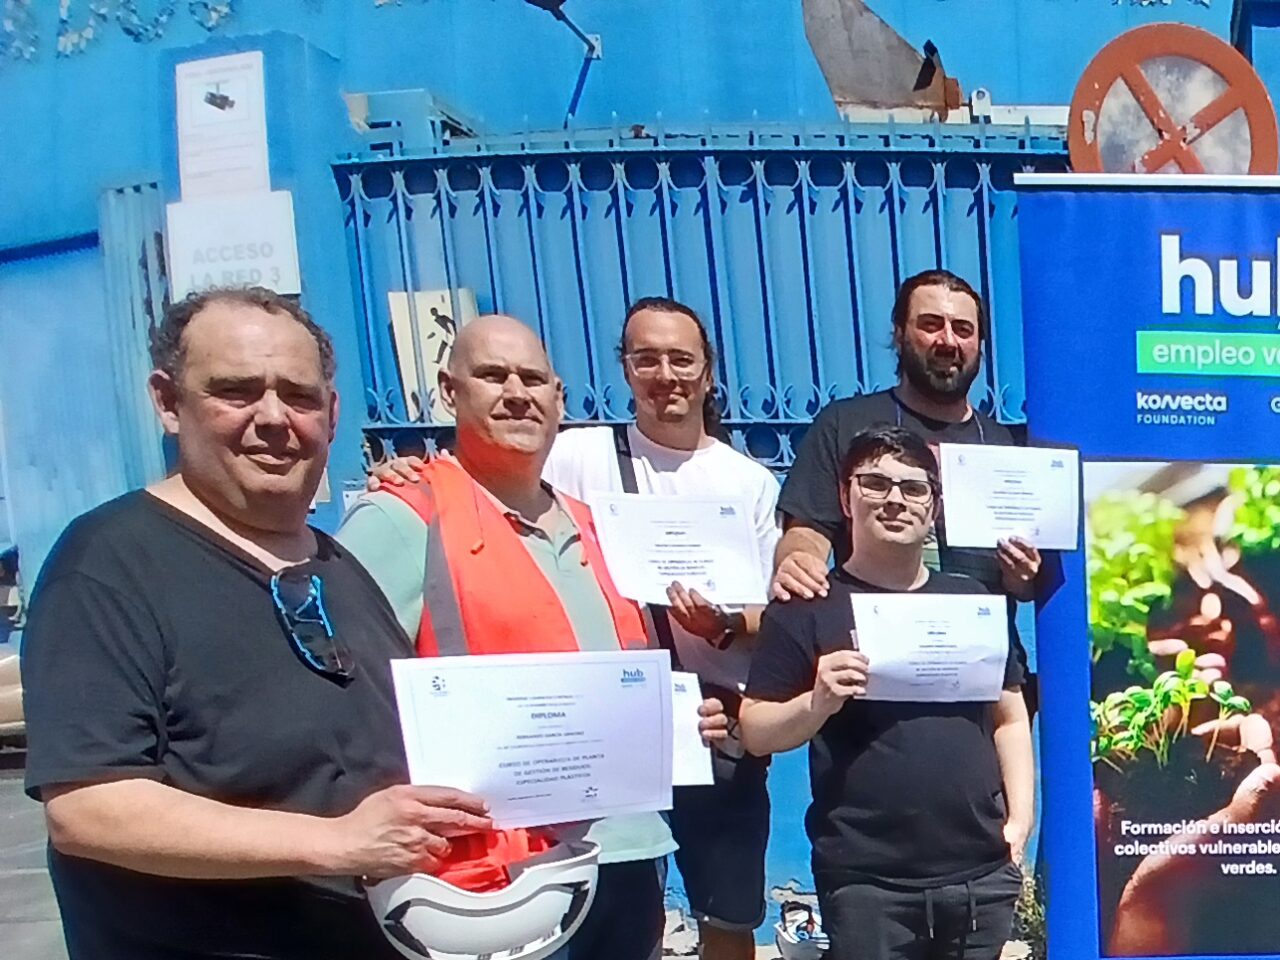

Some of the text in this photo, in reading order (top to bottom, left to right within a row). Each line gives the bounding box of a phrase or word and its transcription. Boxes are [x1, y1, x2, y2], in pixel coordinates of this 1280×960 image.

[193, 241, 273, 264] ACCESO
[1152, 339, 1256, 370] empleo
[1136, 415, 1216, 425] FOUNDATION
[622, 668, 644, 678] hub
[1121, 820, 1206, 835] Formación
[1209, 823, 1220, 834] e
[1114, 840, 1197, 855] colectivos
[1221, 860, 1278, 874] verdes.
